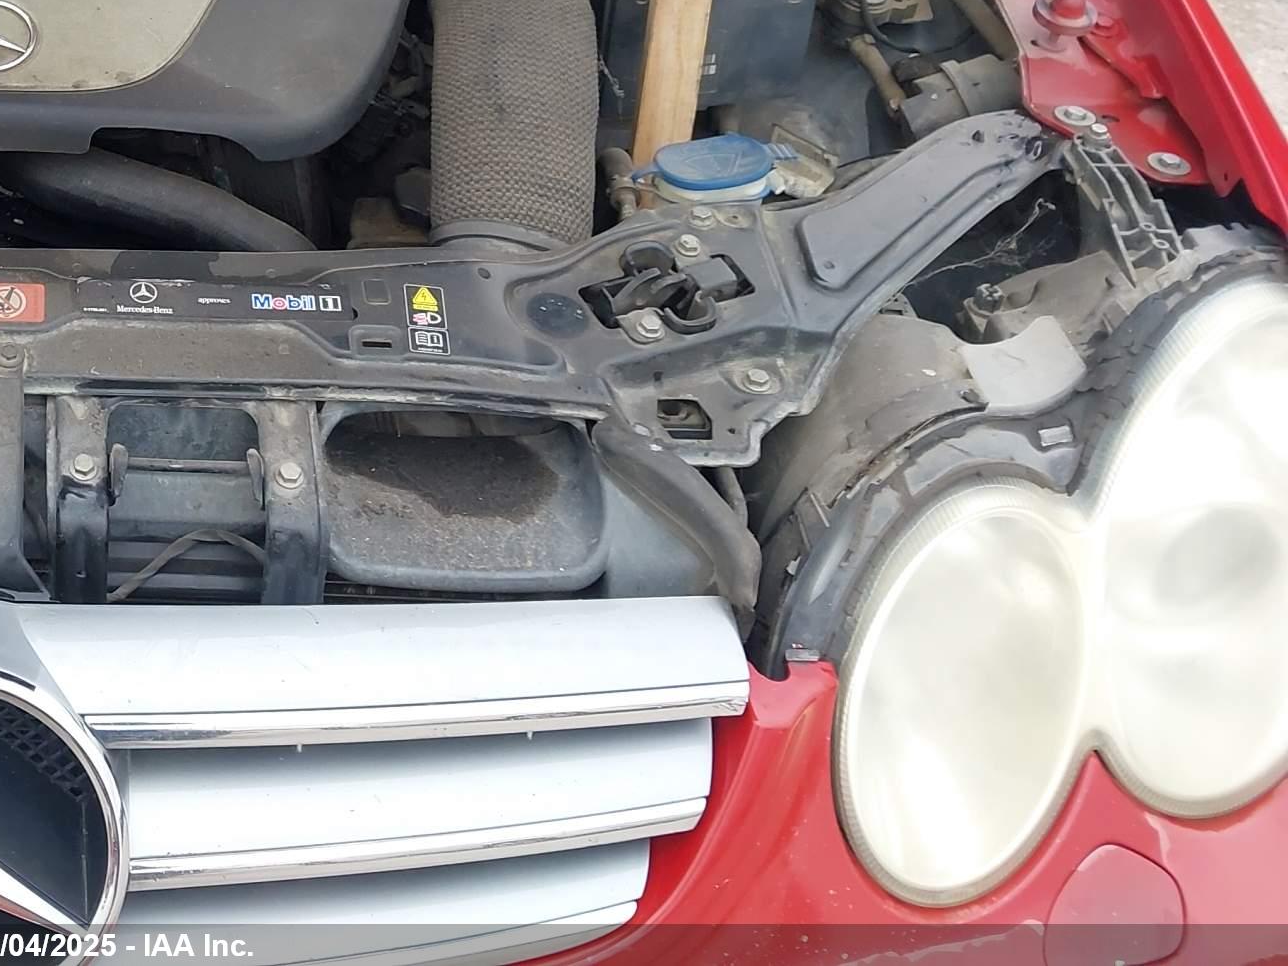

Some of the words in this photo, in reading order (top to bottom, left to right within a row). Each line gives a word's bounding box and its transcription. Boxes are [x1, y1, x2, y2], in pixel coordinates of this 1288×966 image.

[197, 296, 232, 305] approves
[251, 293, 316, 311] Mobil
[320, 295, 341, 310] 1
[116, 304, 174, 315] Mercedes-Benz
